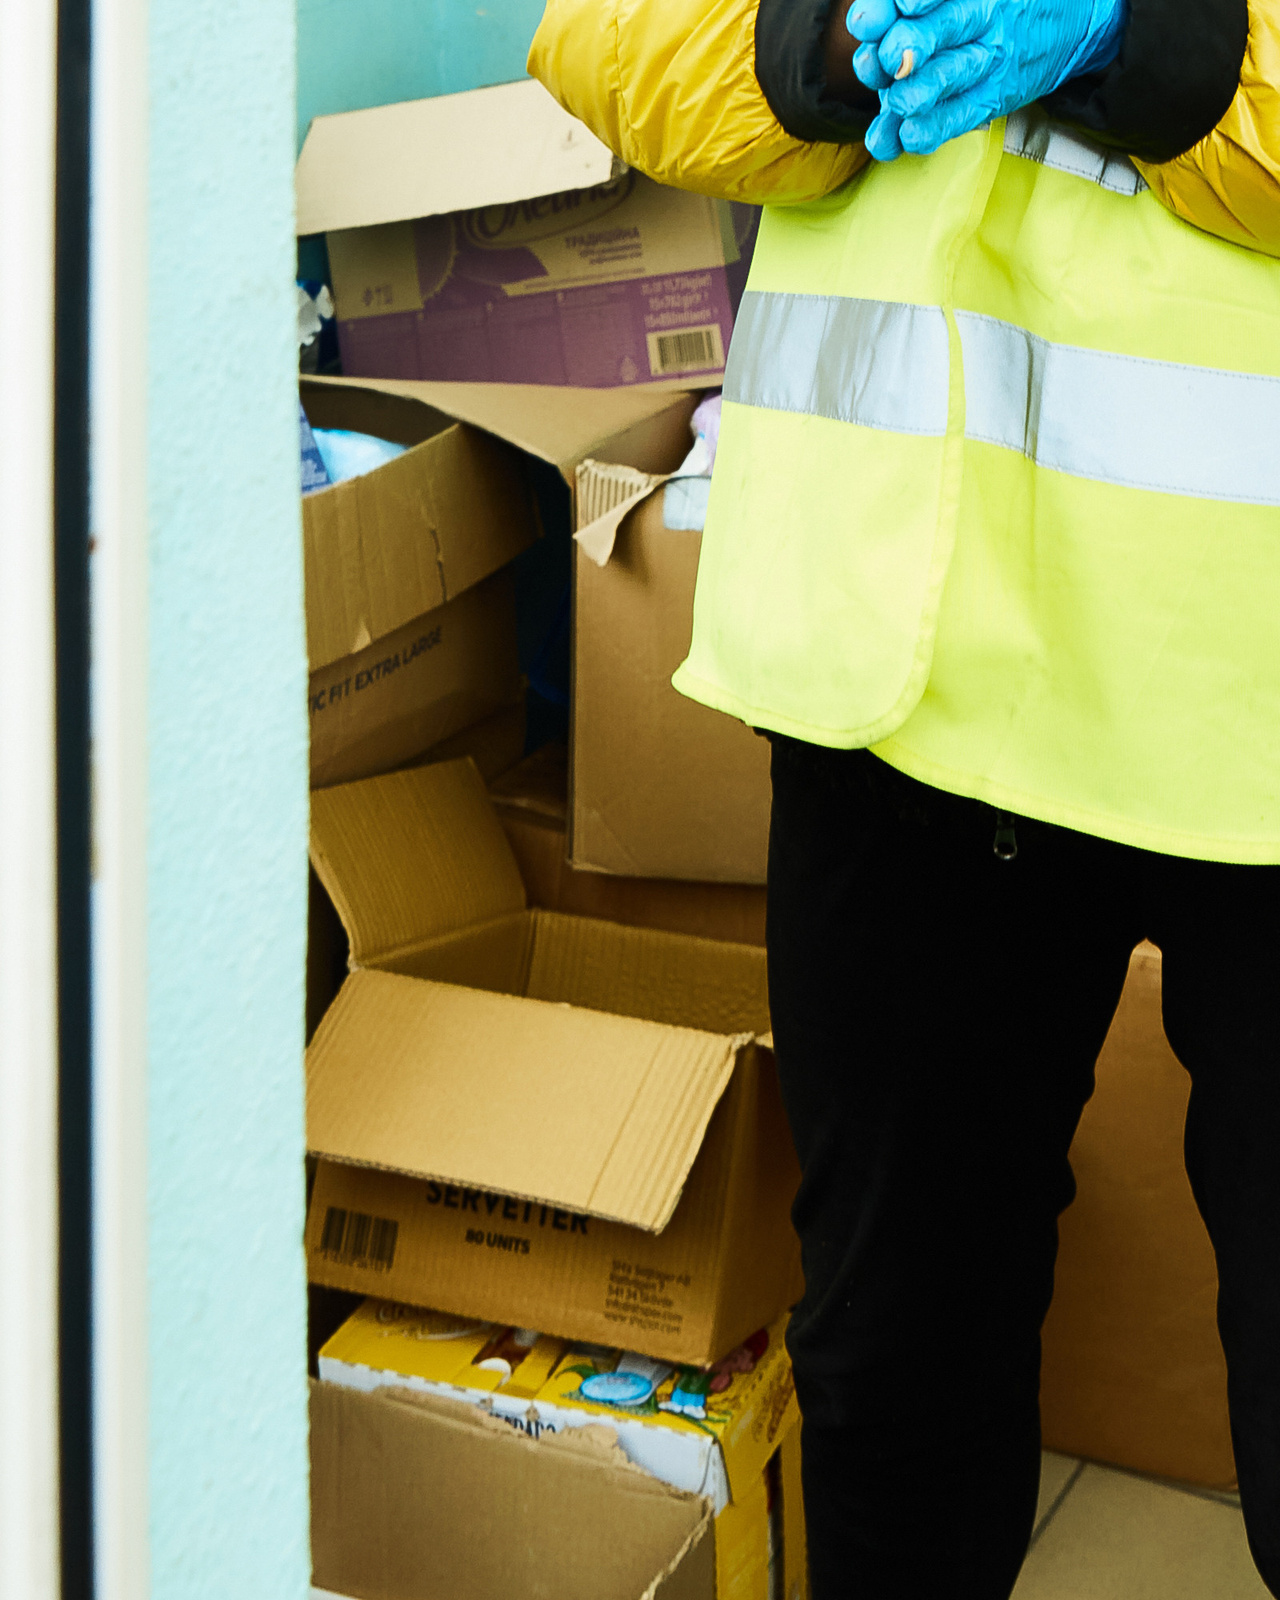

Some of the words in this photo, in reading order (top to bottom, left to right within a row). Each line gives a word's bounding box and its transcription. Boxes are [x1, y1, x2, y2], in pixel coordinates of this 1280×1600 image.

[329, 677, 351, 704] FIT
[354, 654, 400, 692] EXTRA
[402, 625, 442, 666] LARGE
[426, 1180, 590, 1236] SERVETTER
[465, 1229, 484, 1246] 80
[486, 1232, 531, 1255] UNITS
